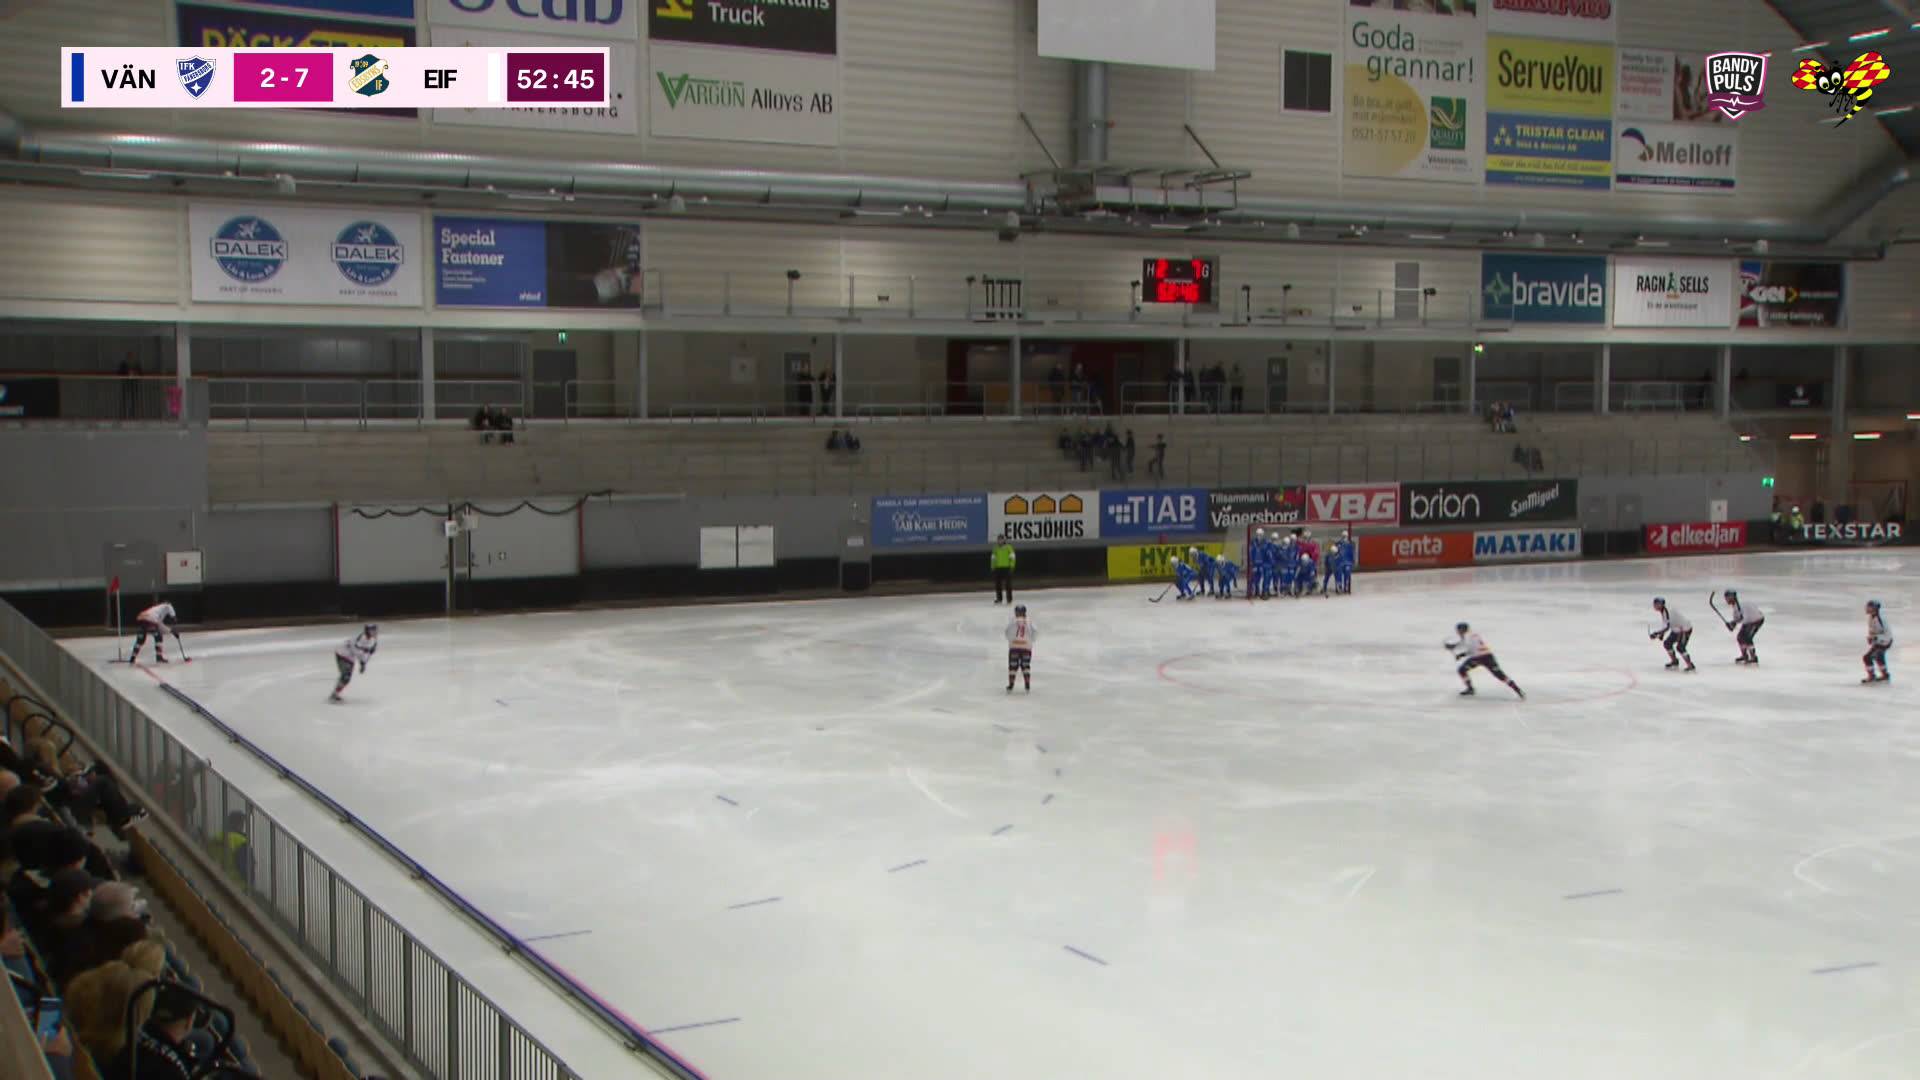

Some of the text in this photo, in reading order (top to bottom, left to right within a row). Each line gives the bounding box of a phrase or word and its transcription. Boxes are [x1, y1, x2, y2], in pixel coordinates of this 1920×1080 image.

[707, 2, 765, 27] Truck
[1352, 21, 1415, 51] Goda
[1367, 54, 1473, 83] grannar!
[1498, 50, 1602, 94] ServeYou
[752, 88, 803, 113] Alloys
[810, 93, 832, 114] AB
[1516, 125, 1605, 141] TRISTAR CLEAN
[1656, 141, 1733, 166] Melloff
[214, 241, 285, 257] DALEK
[441, 228, 496, 248] Special
[335, 246, 400, 261] DALEK
[442, 248, 505, 266] Fastener
[1146, 264, 1155, 277] H
[1202, 263, 1209, 277] G
[1512, 272, 1603, 306] bravida
[1636, 275, 1709, 293] RAGN SELLS
[1128, 495, 1197, 524] TIAB
[1209, 493, 1265, 504] Tillsammans
[1311, 492, 1396, 521] VBG
[1410, 488, 1480, 520] brion
[1004, 517, 1084, 540] EKSJÖHUS
[1211, 505, 1299, 529] Vänersborg
[1671, 524, 1740, 548] elkedjan
[1801, 522, 1901, 540] TEXSTAR
[1392, 537, 1443, 556] renta
[1475, 533, 1576, 555] MATAKI
